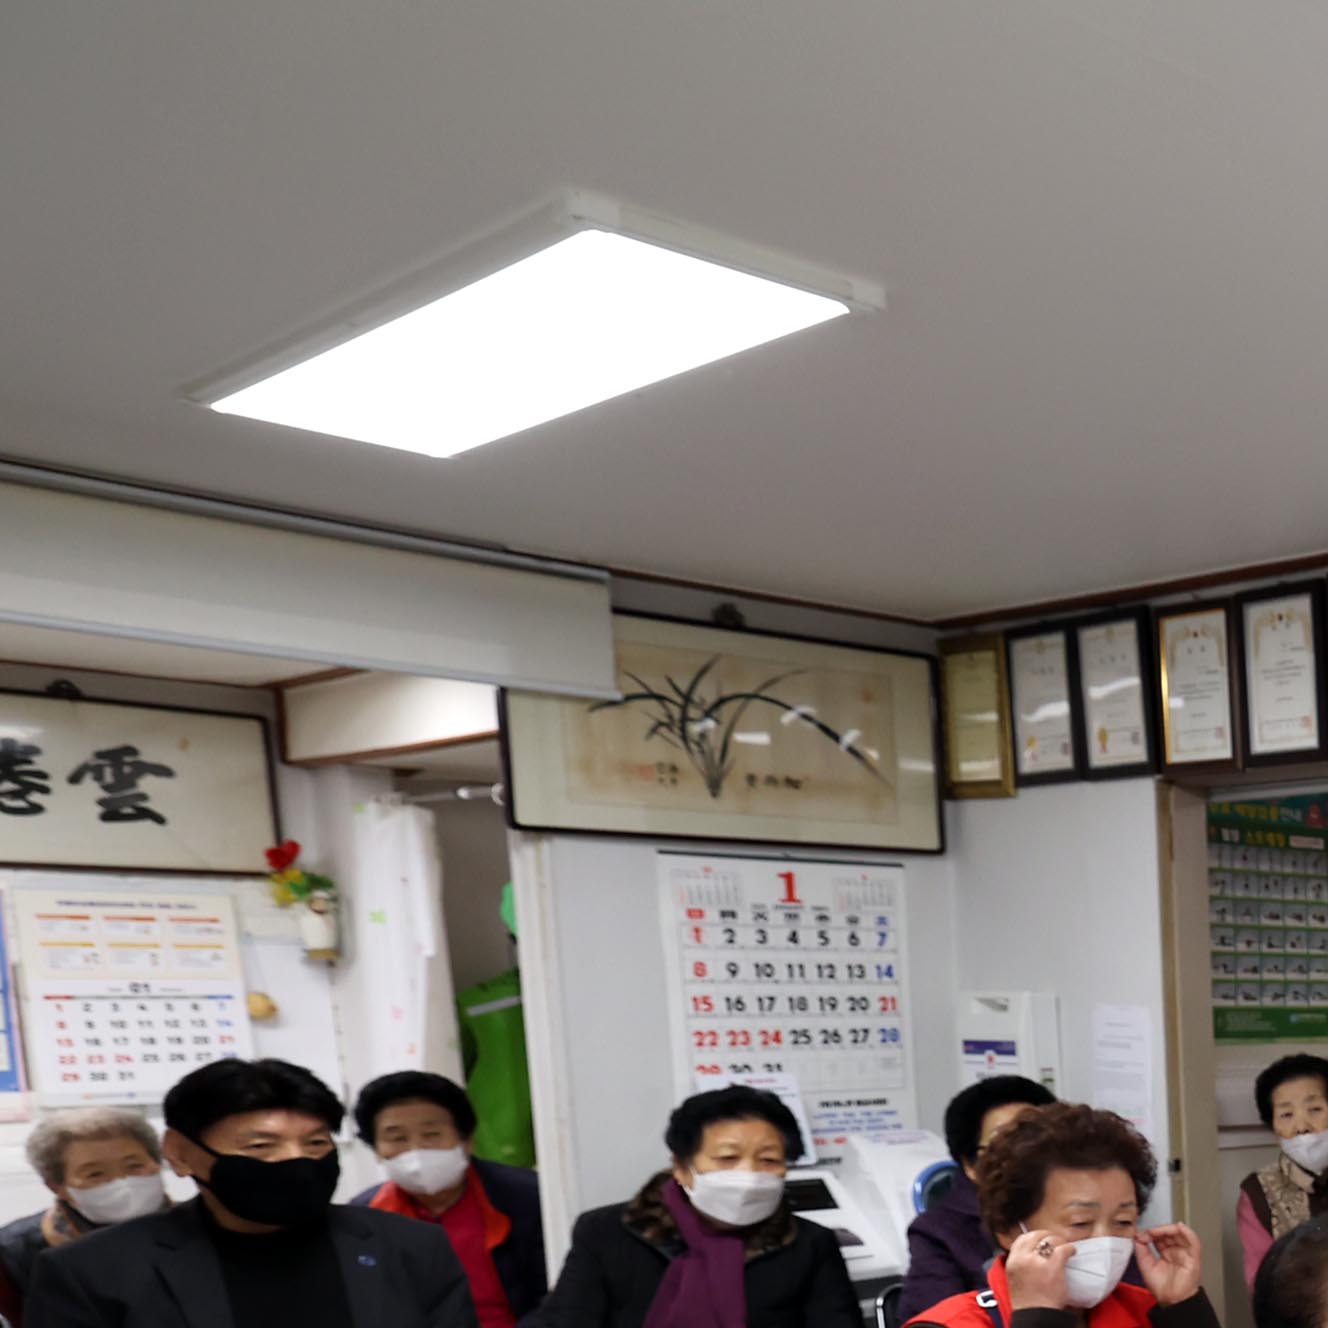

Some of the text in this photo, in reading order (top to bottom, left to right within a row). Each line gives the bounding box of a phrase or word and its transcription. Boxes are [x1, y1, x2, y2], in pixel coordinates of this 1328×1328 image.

[777, 871, 802, 904] 1
[693, 927, 888, 947] 1 2 3 4 5 6 7
[694, 962, 894, 979] 8 9 10 11 12 13 14
[691, 996, 898, 1012] 15 16 17 18 19 20 21
[693, 1028, 899, 1047] 22 23 24 25 26 27 28
